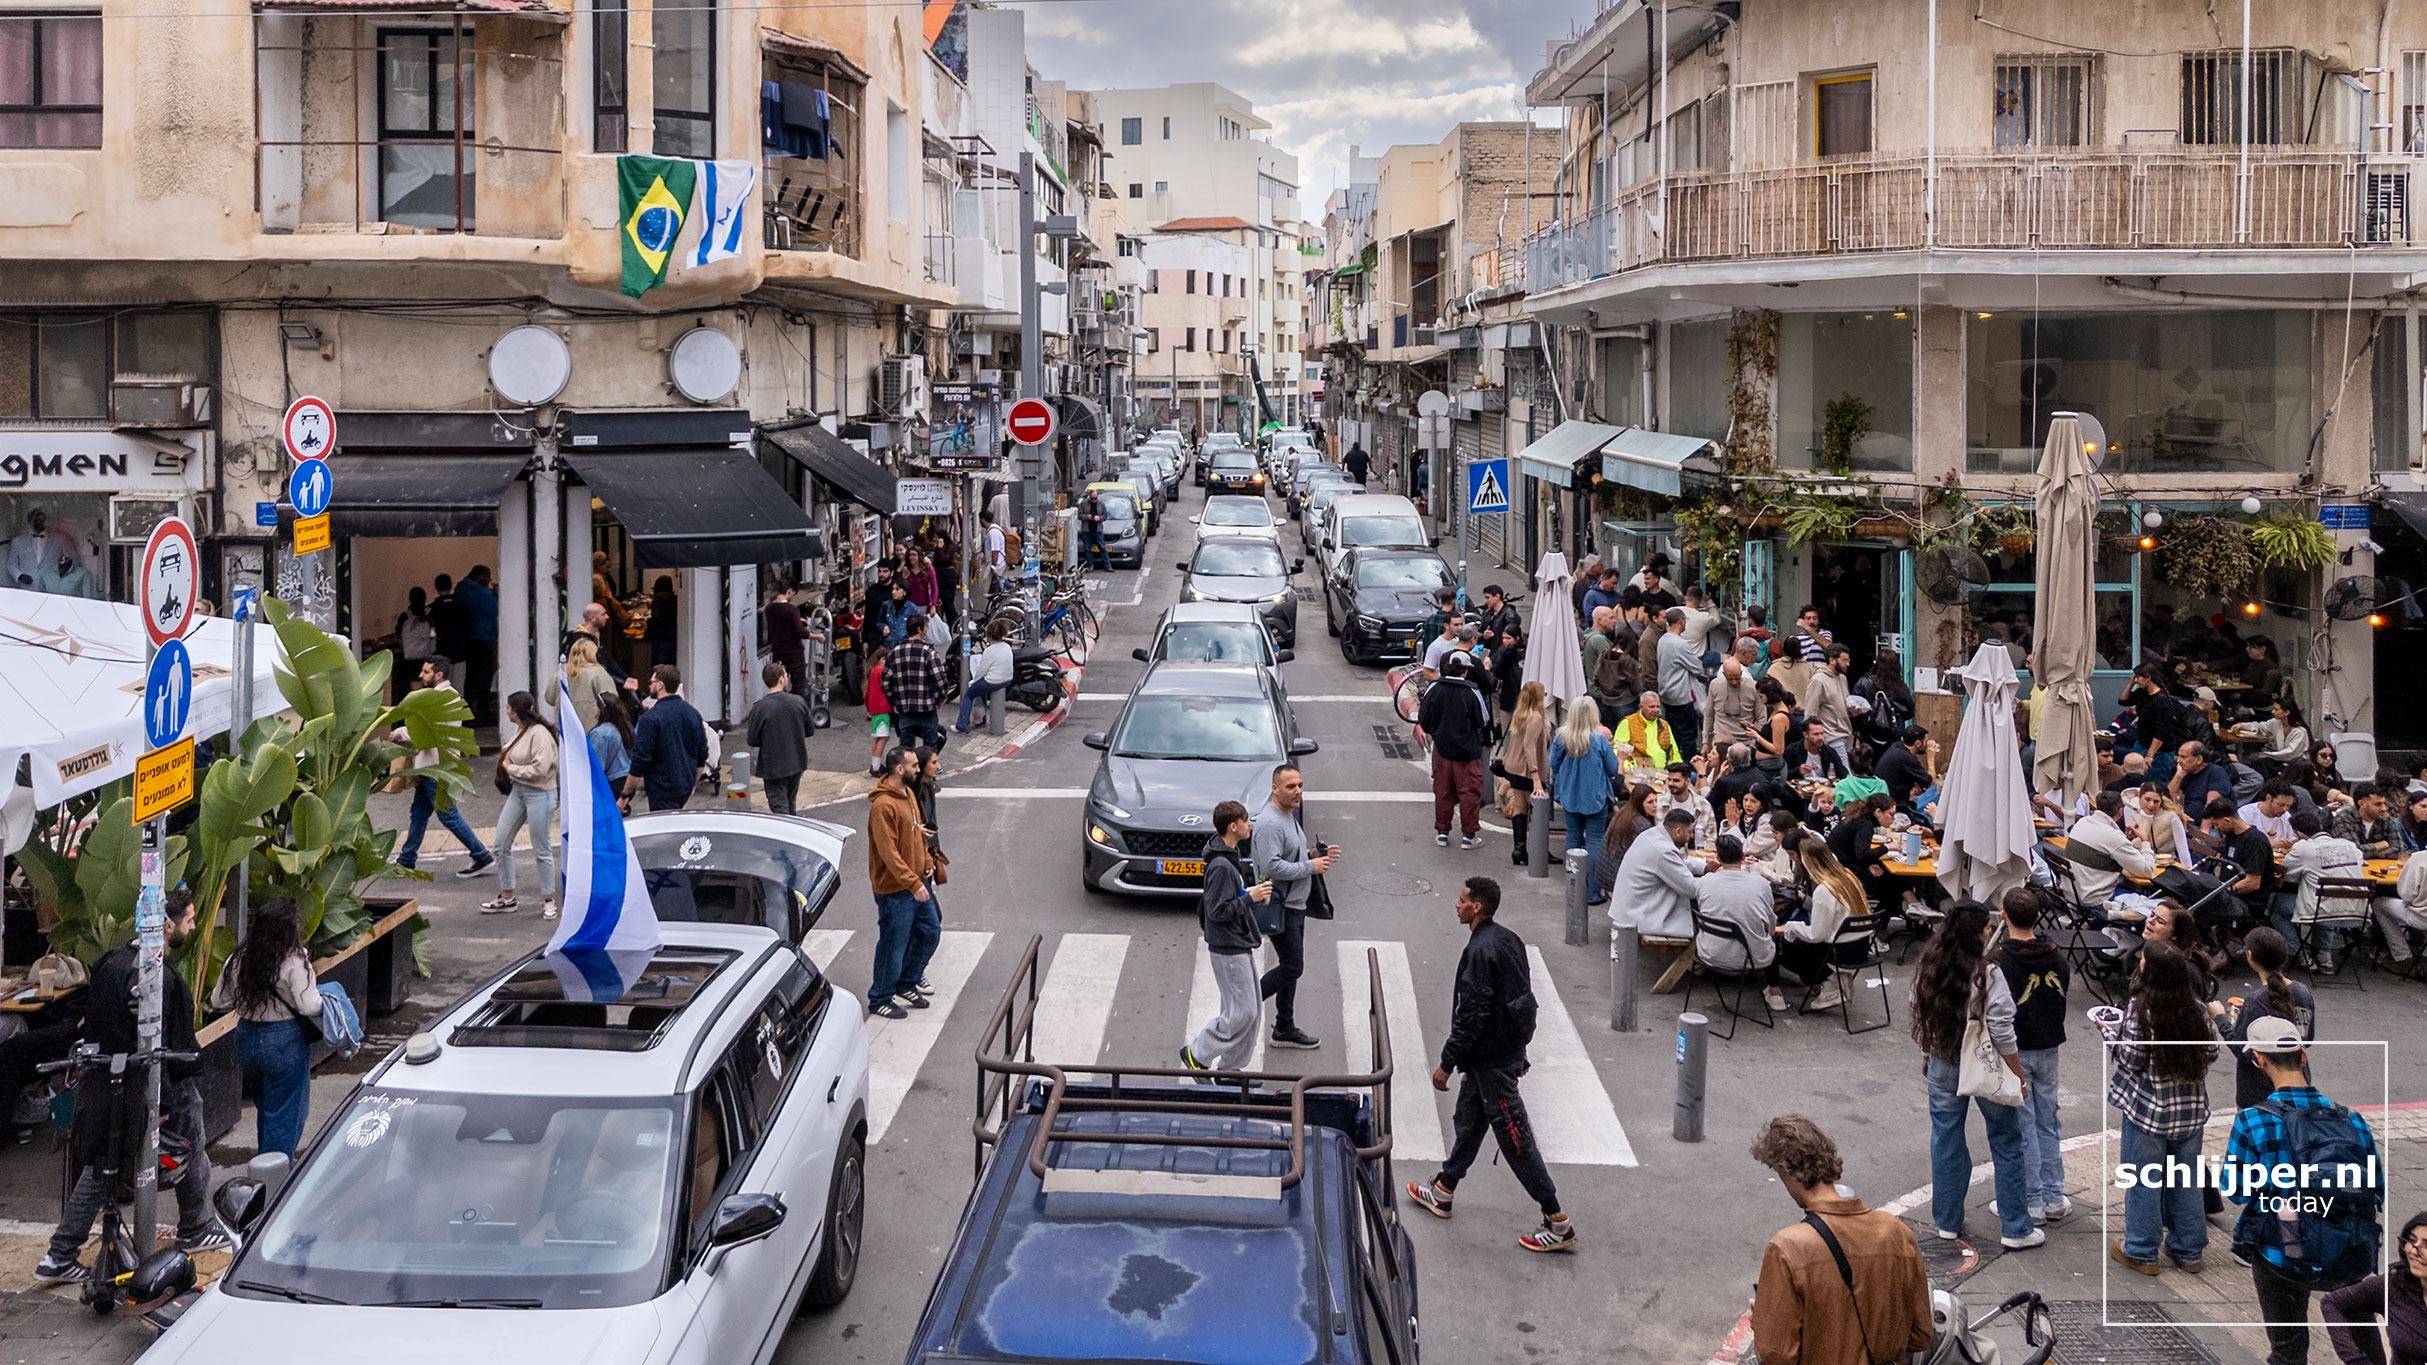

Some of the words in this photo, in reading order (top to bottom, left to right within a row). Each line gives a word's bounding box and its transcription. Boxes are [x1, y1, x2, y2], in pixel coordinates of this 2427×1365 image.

[60, 749, 109, 778] גולדסטאר
[171, 748, 191, 769] למעט
[139, 761, 170, 783] אופניים
[177, 775, 187, 790] לא
[143, 783, 176, 806] ממונעים
